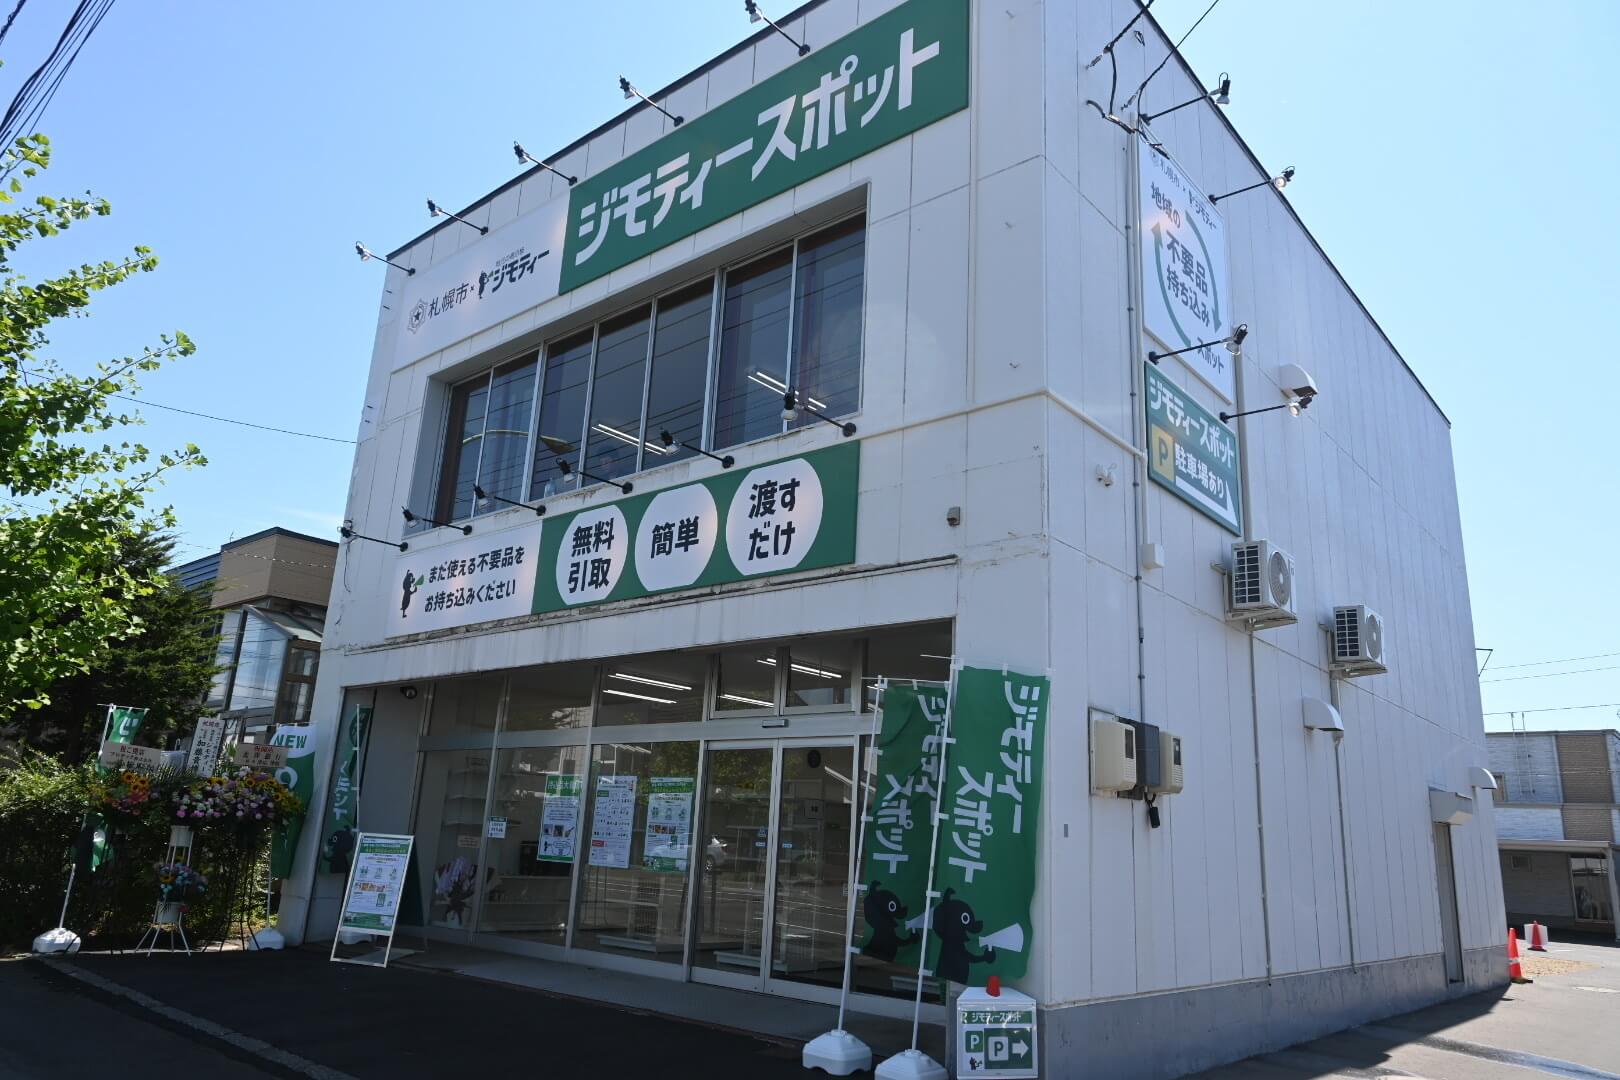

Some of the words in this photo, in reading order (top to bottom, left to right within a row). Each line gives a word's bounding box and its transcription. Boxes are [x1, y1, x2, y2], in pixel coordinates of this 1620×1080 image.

[576, 28, 940, 266] ジモティースポット
[1151, 181, 1181, 229] 地域の
[492, 250, 550, 293] ジモティー
[1166, 230, 1209, 298] 不要品
[428, 282, 470, 318] 札幌市
[1166, 265, 1211, 328] 持ち込み
[1150, 380, 1234, 469] ジモティースポット
[1159, 436, 1169, 467] P
[1175, 443, 1225, 499] 駐車場あり
[748, 477, 801, 519] 渡す
[571, 517, 615, 557] 無料
[650, 515, 700, 559] 簡単
[748, 520, 796, 561] だけ
[429, 545, 525, 583] まだ使える不要品を
[567, 557, 612, 594] 引取
[424, 579, 517, 613] お持ち込みください
[274, 734, 308, 749] NEW
[996, 680, 1041, 834] ジモティー
[873, 773, 915, 874] スポット
[948, 765, 994, 883] スポット
[970, 1035, 980, 1050] P
[994, 1041, 1004, 1057] P
